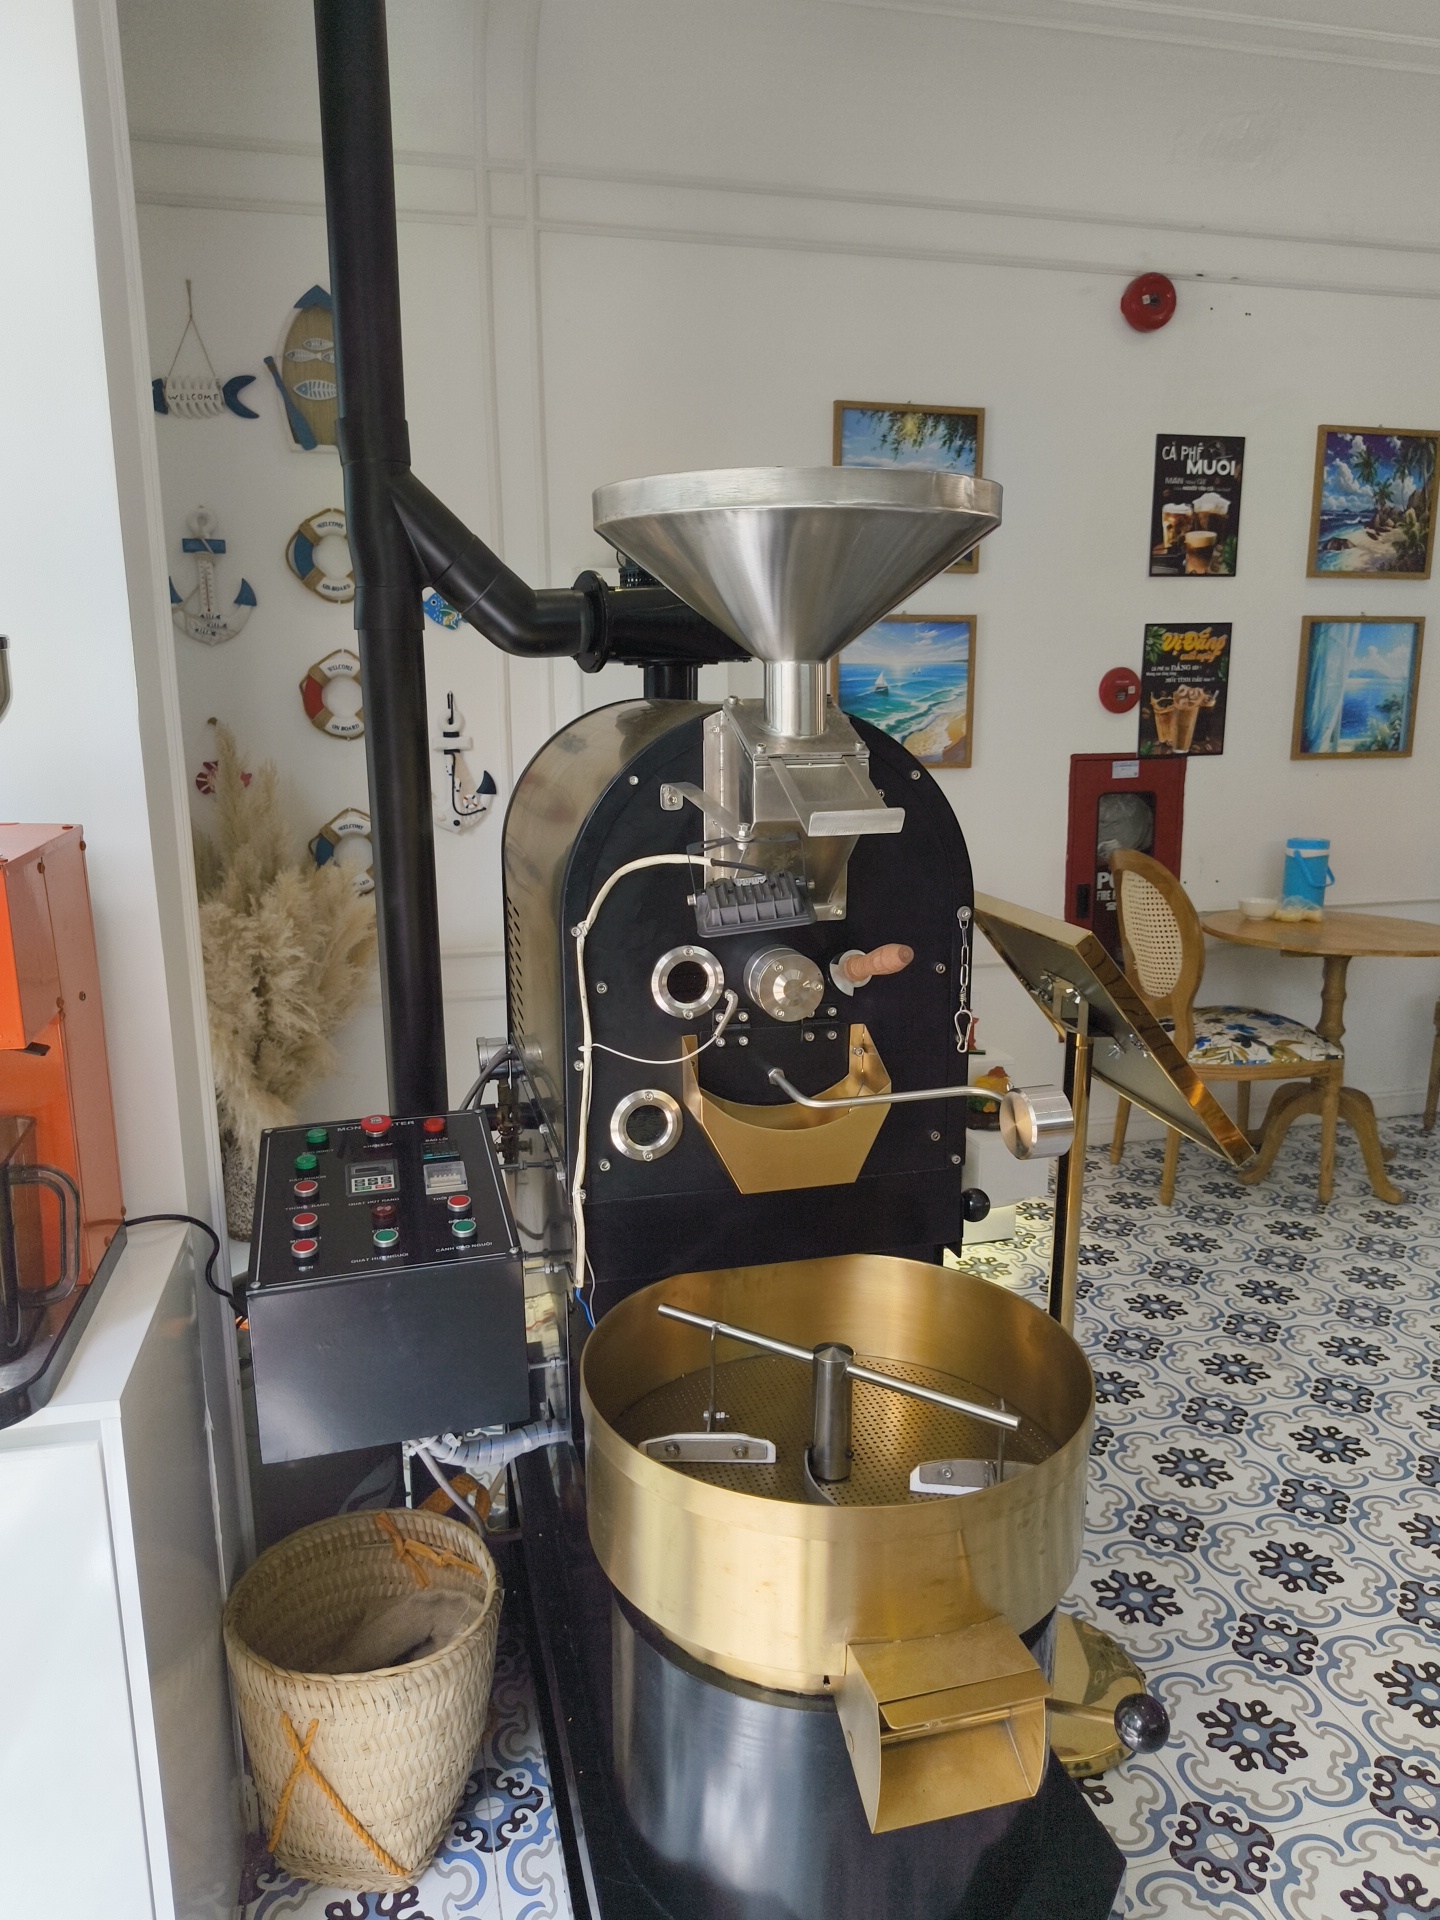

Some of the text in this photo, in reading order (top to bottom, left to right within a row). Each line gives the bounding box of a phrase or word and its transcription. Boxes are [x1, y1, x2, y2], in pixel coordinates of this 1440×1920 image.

[168, 393, 220, 401] WELCOME
[317, 521, 344, 529] WELCOME
[327, 664, 353, 672] WELCOME
[331, 723, 360, 732] ON BOARD
[338, 823, 364, 831] WELCOME
